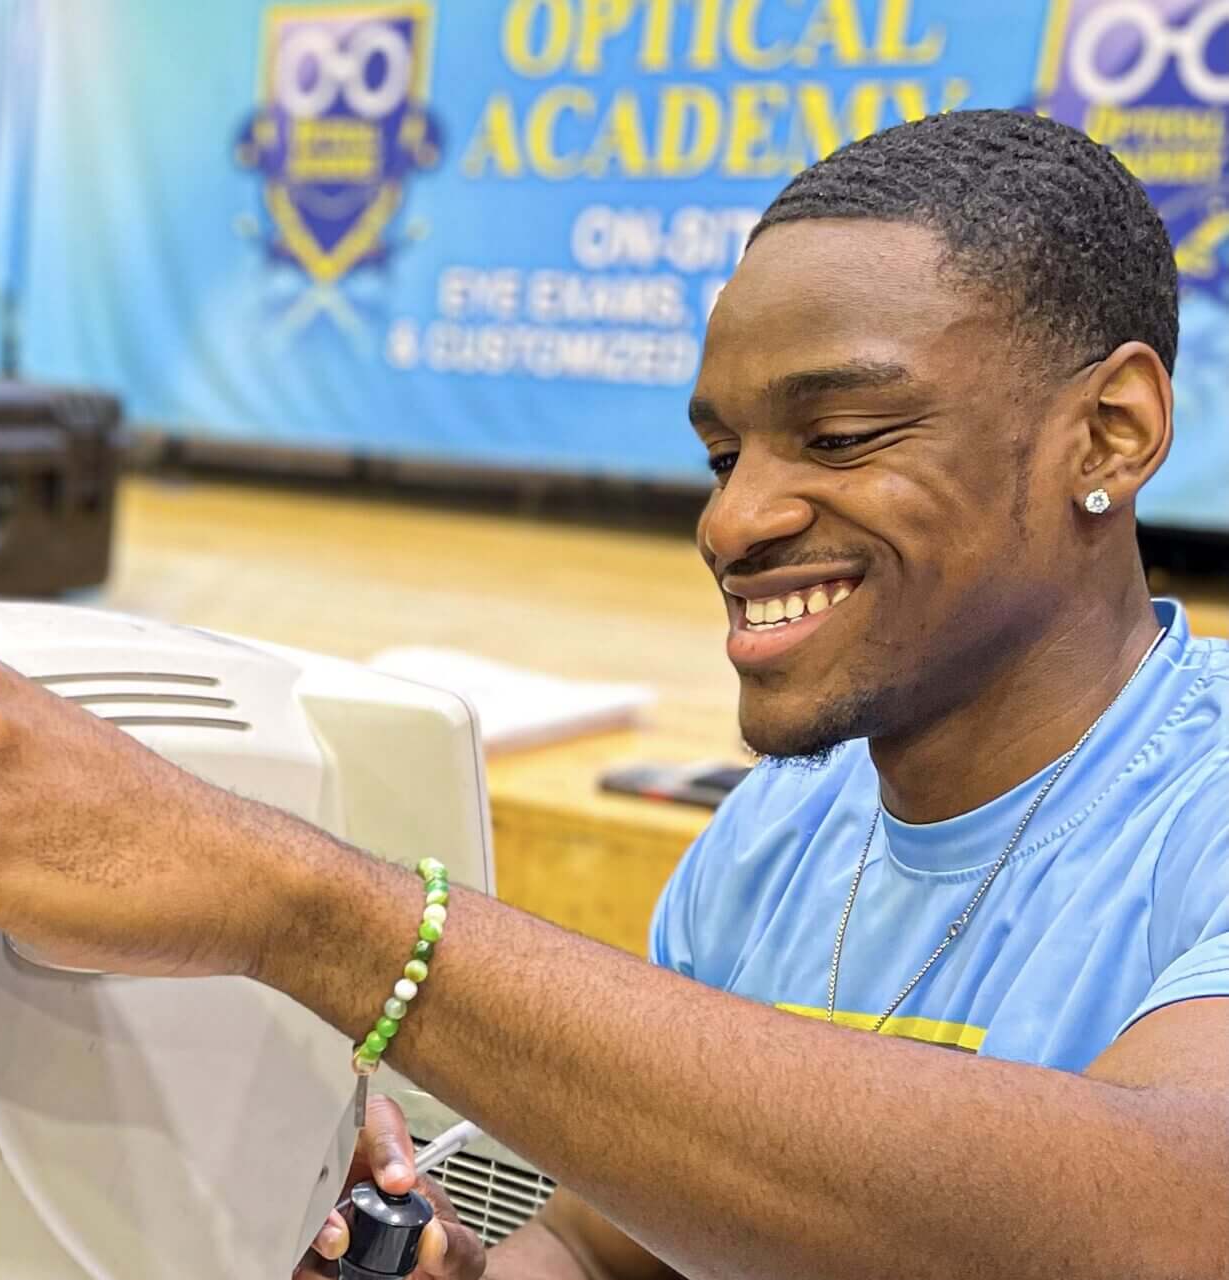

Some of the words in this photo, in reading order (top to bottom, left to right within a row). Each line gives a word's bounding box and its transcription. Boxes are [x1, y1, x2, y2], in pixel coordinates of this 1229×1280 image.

[504, 0, 943, 77] OPTICAL
[462, 81, 967, 179] ACADEM
[575, 206, 760, 269] ON-SIT
[430, 323, 698, 383] CUSTOMIZED
